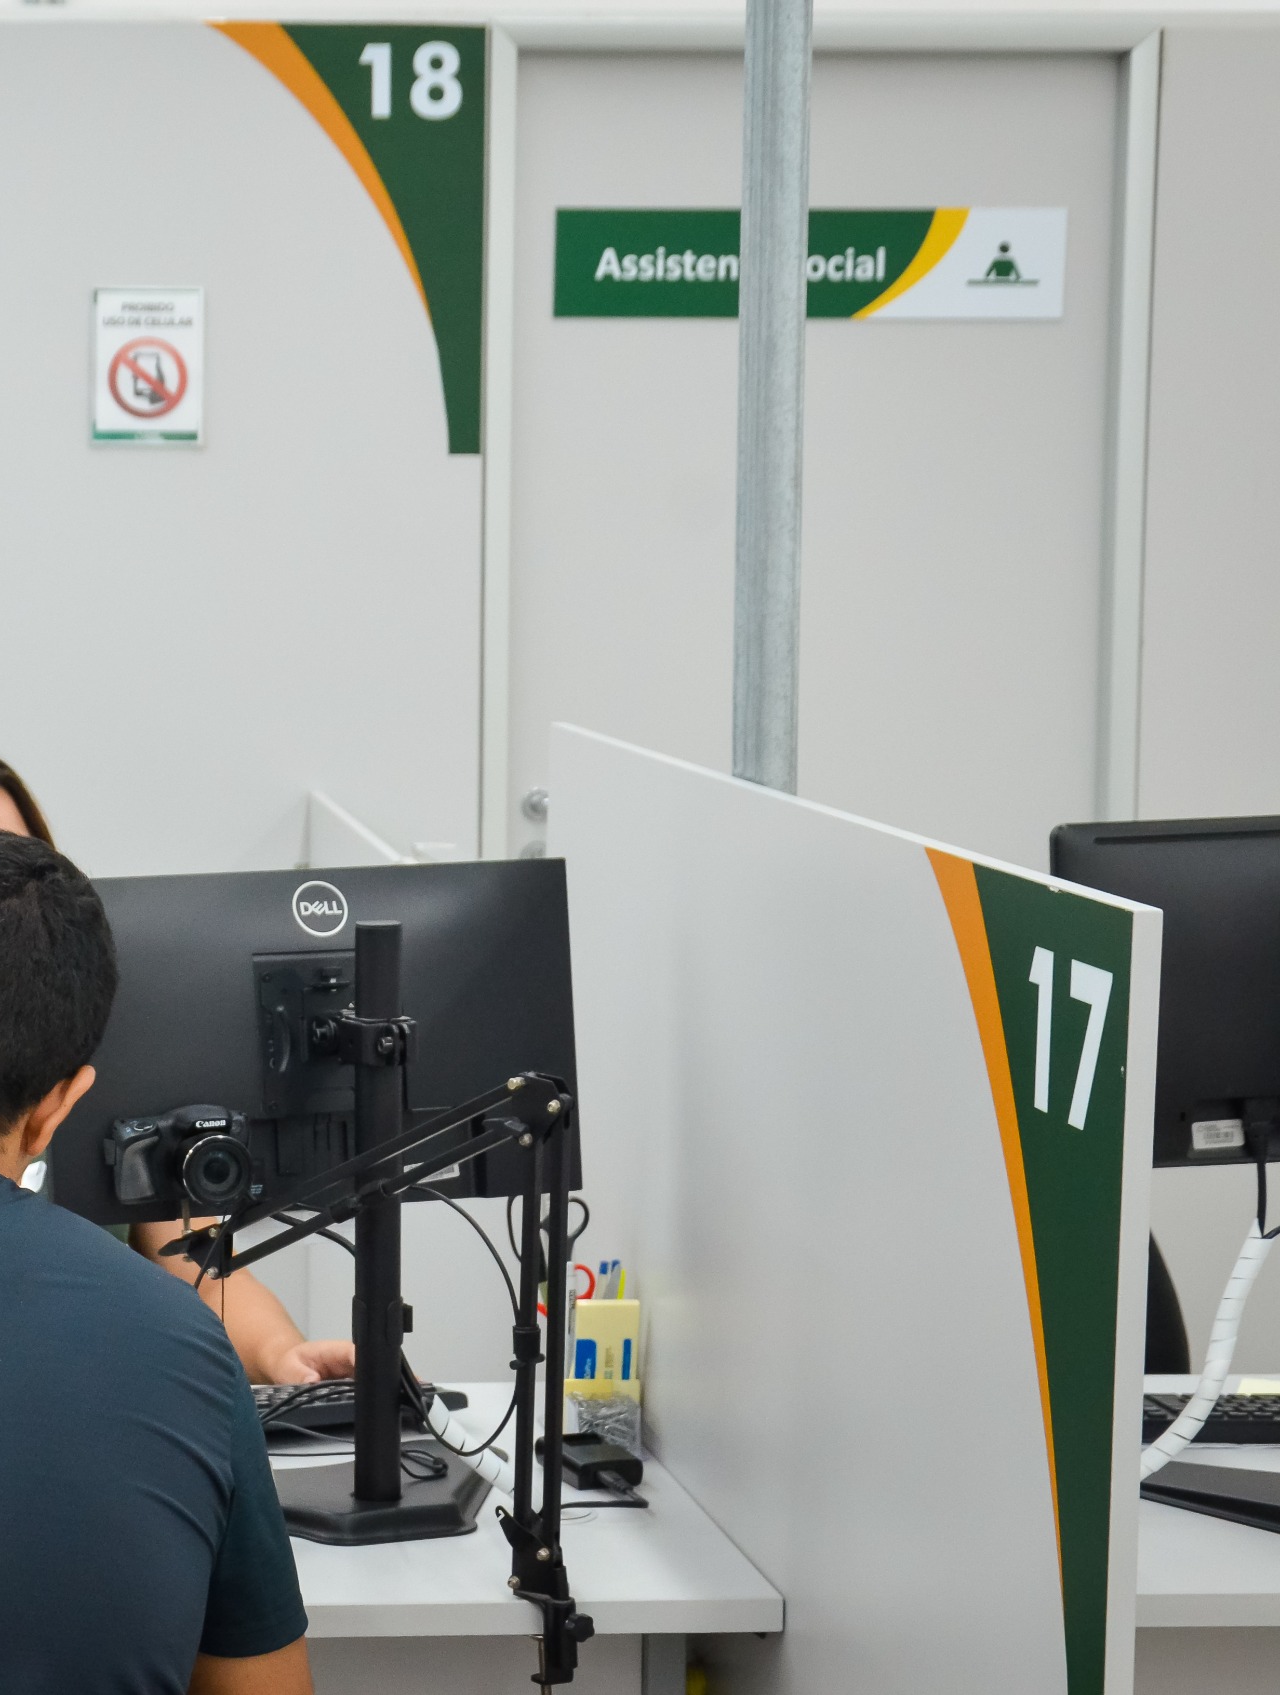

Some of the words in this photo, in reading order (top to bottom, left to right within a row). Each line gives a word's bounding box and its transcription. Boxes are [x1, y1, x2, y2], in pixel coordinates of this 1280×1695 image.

[358, 40, 464, 120] 18
[594, 246, 739, 282] Assisten
[806, 246, 886, 282] ocial
[103, 316, 126, 328] USO
[128, 316, 141, 328] DE
[144, 316, 193, 328] CELULAR
[299, 900, 343, 915] DELL
[1028, 945, 1113, 1131] 17
[195, 1119, 227, 1128] Canon
